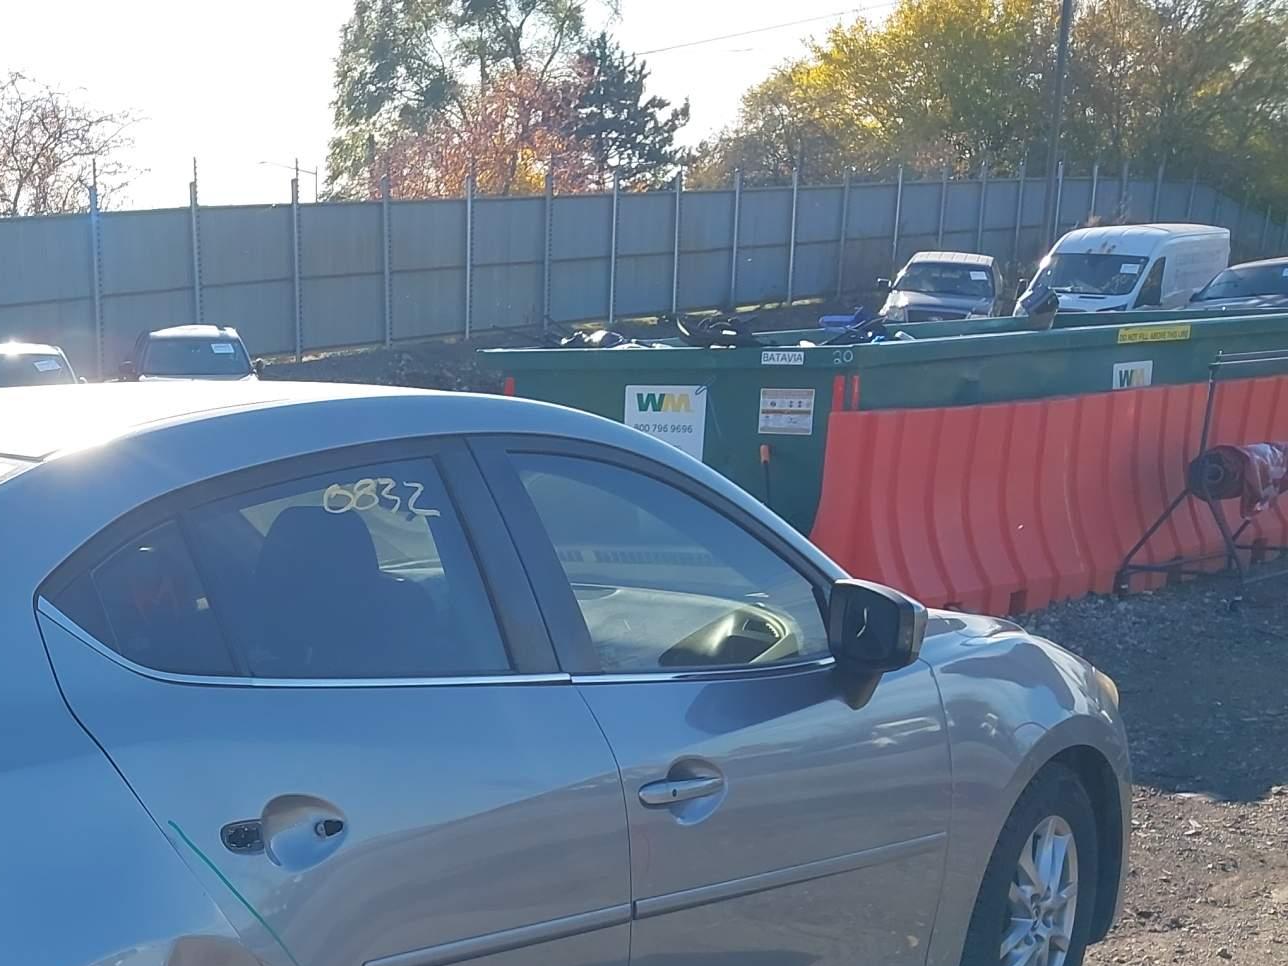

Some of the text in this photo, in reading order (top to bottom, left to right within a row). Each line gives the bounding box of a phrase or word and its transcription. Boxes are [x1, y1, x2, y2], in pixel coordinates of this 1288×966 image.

[762, 352, 803, 362] BATAVIA
[1119, 368, 1144, 388] WM
[636, 393, 693, 412] WM
[652, 424, 669, 433] 796
[670, 424, 693, 434] 9696
[323, 477, 441, 517] 0832
